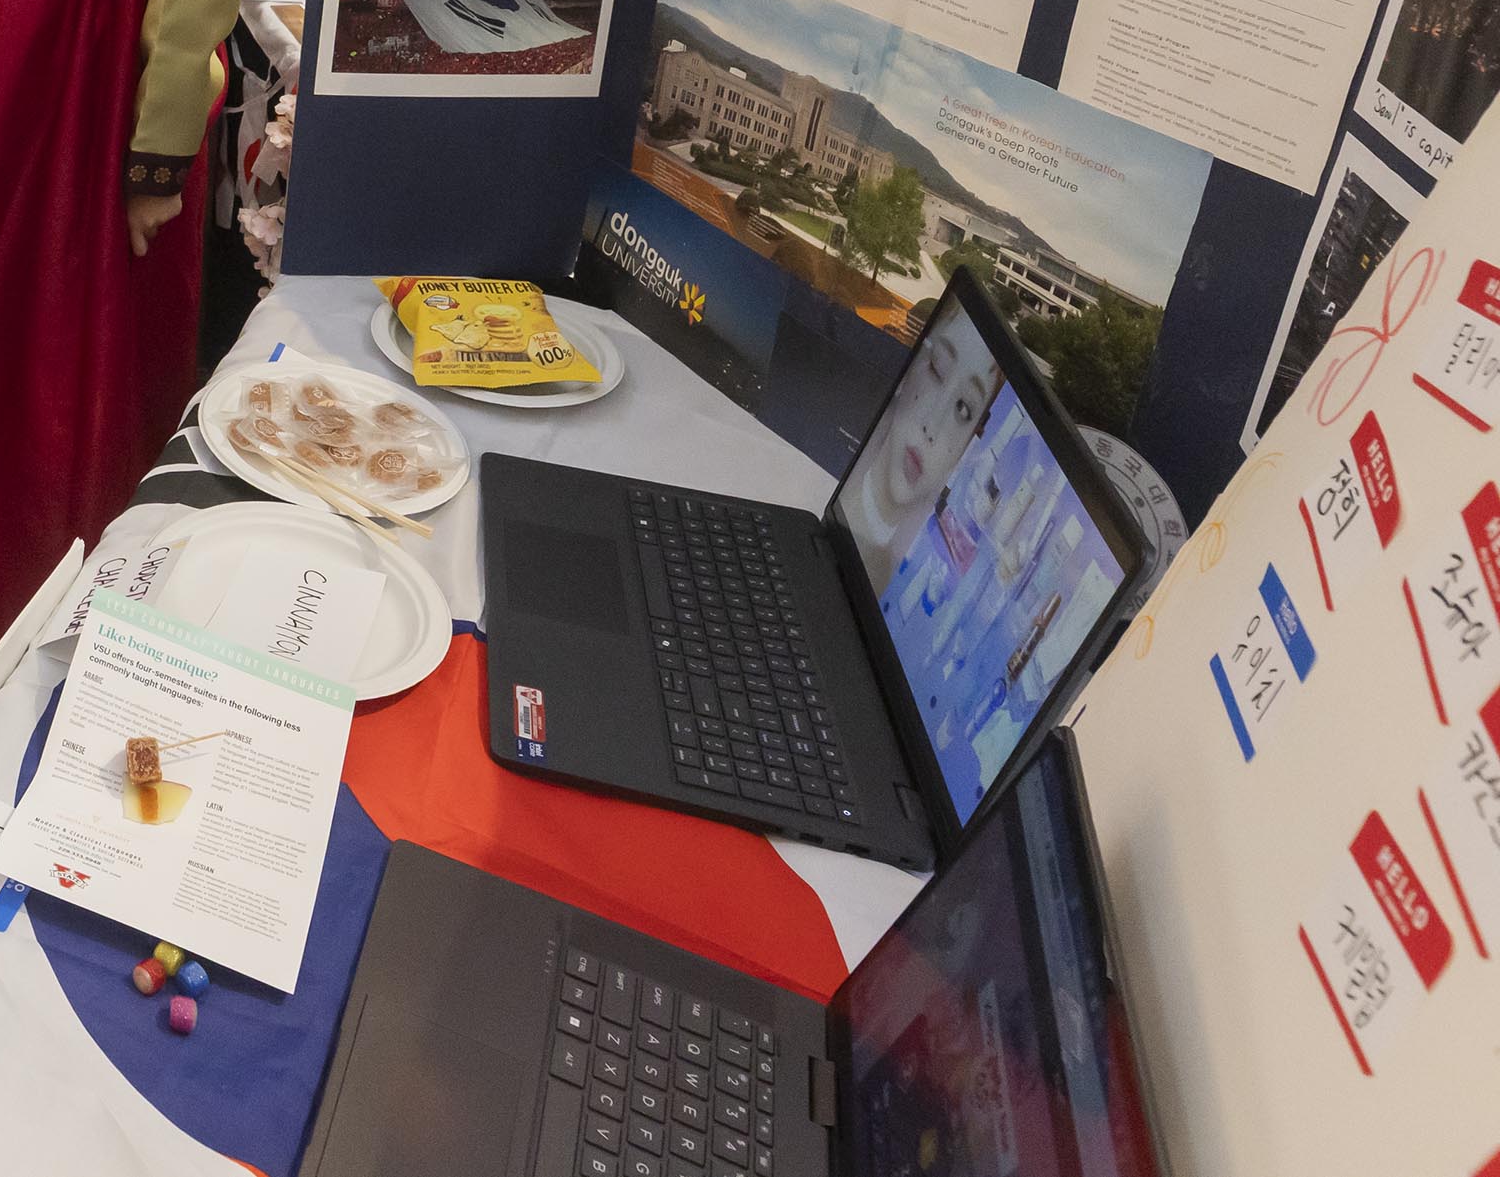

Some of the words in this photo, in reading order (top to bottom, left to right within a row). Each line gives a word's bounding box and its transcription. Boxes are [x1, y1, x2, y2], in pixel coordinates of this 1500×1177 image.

[935, 107, 995, 139] Dongguk's
[992, 132, 1026, 154] Deep
[1026, 146, 1060, 168] Roots
[941, 94, 952, 104] A
[949, 99, 983, 120] Great
[980, 112, 1008, 130] Tree
[1008, 122, 1020, 135] in
[1020, 127, 1064, 153] Korean
[1064, 147, 1126, 182] Education
[1405, 121, 1415, 141] is
[934, 120, 987, 154] Generate
[988, 148, 996, 156] a
[998, 149, 1038, 176] Greater
[1042, 168, 1079, 194] Future
[602, 234, 679, 308] UNIVERSITY
[611, 211, 683, 291] dongguk
[418, 282, 461, 295] HONEY
[464, 281, 513, 294] BUTTER
[535, 348, 572, 367] 100%
[1367, 438, 1394, 504] HELLO
[268, 569, 327, 662] CINNAMON
[98, 623, 126, 646] Like
[128, 633, 164, 663] being
[166, 649, 218, 683] unique?
[105, 599, 133, 617] LESS
[140, 614, 207, 649] COMMONLY
[213, 643, 260, 670] TAUGHT
[264, 663, 342, 701] LANGUAGES
[82, 670, 104, 685] ARABIC
[88, 654, 131, 677] commonly
[132, 671, 158, 688] taught
[158, 681, 204, 709] languages:
[92, 642, 112, 655] VSU
[112, 648, 135, 664] offers
[135, 658, 192, 689] four-semester
[194, 682, 217, 699] suites
[219, 694, 227, 704] in
[229, 698, 242, 710] the
[244, 703, 283, 727] following
[284, 717, 301, 733] less
[62, 739, 86, 755] CHINESE
[224, 728, 252, 745] JAPANESE
[206, 800, 223, 813] LATIN
[34, 817, 60, 829] Modern
[69, 830, 102, 845] Classical
[103, 843, 141, 861] Languages
[188, 859, 215, 875] RUSSIAN
[1376, 845, 1430, 929] HELLO
[578, 957, 587, 972] CTRL
[654, 987, 662, 1006] CAPS
[692, 1003, 700, 1017] TAB
